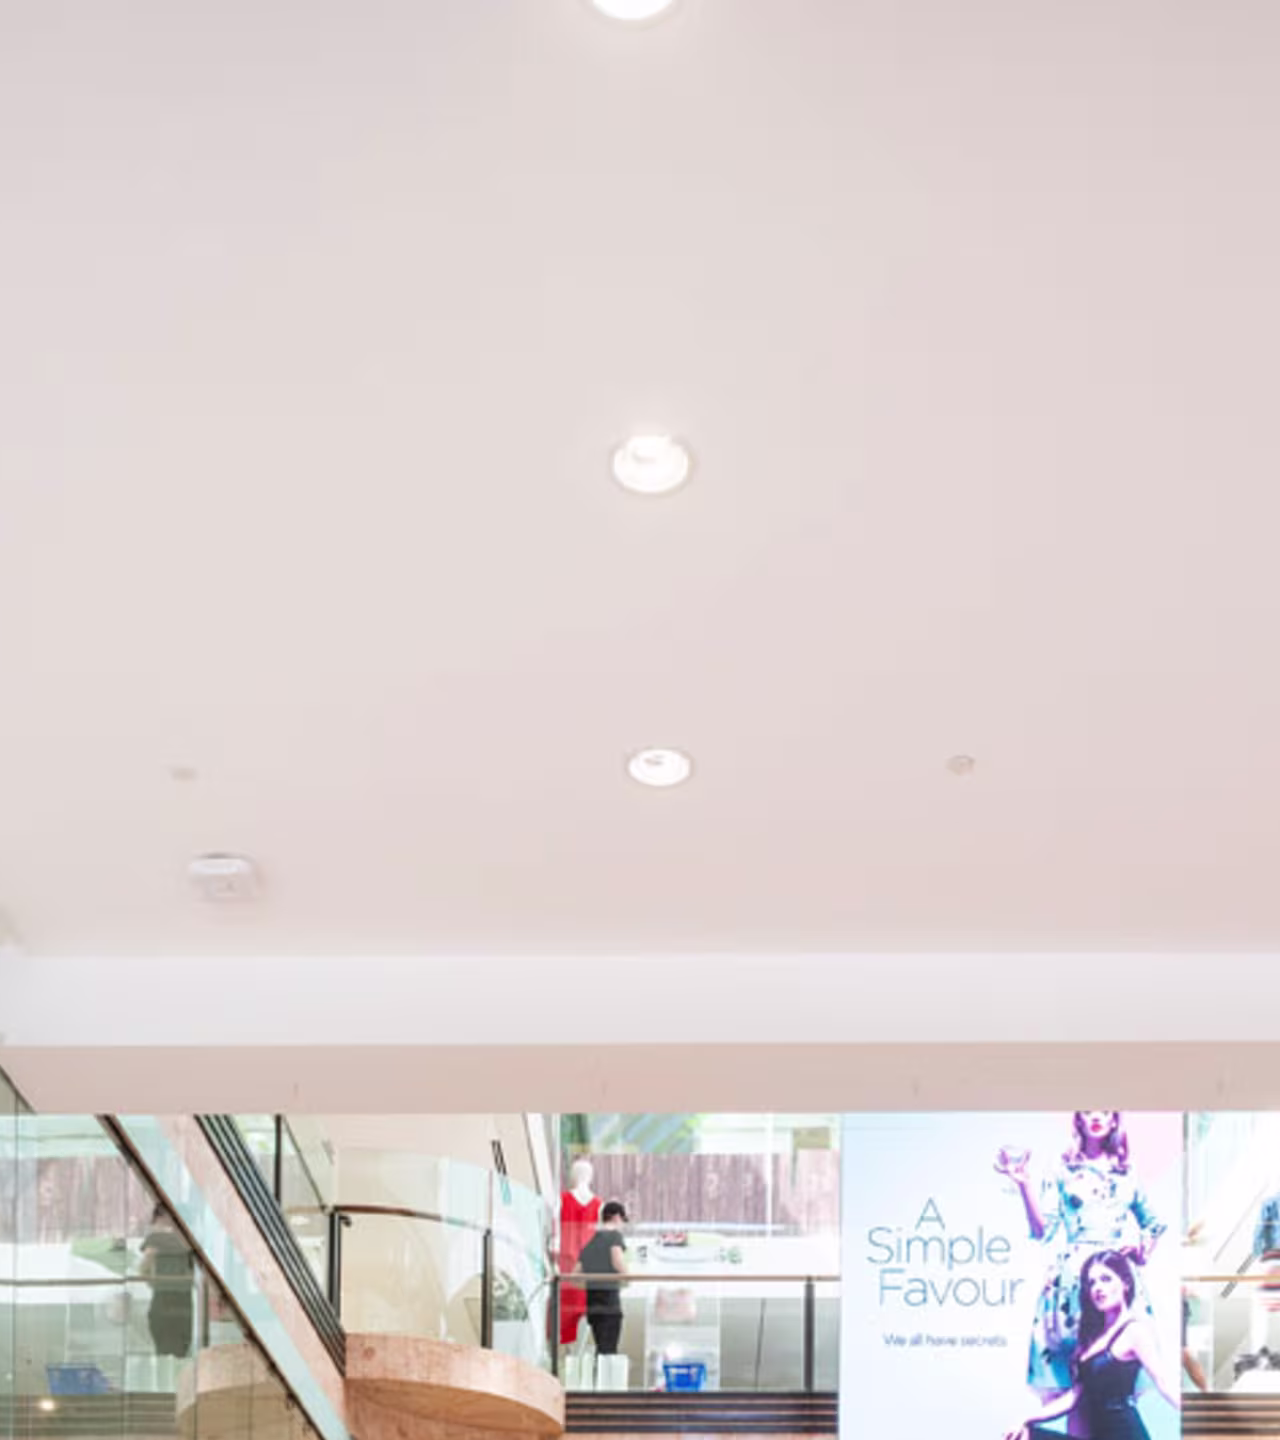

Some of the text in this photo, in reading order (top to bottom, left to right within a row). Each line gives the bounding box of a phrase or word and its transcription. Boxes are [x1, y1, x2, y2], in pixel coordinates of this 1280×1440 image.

[915, 1197, 945, 1231] A
[866, 1224, 1012, 1271] Simple
[878, 1267, 1026, 1307] Favour
[883, 1334, 907, 1347] We
